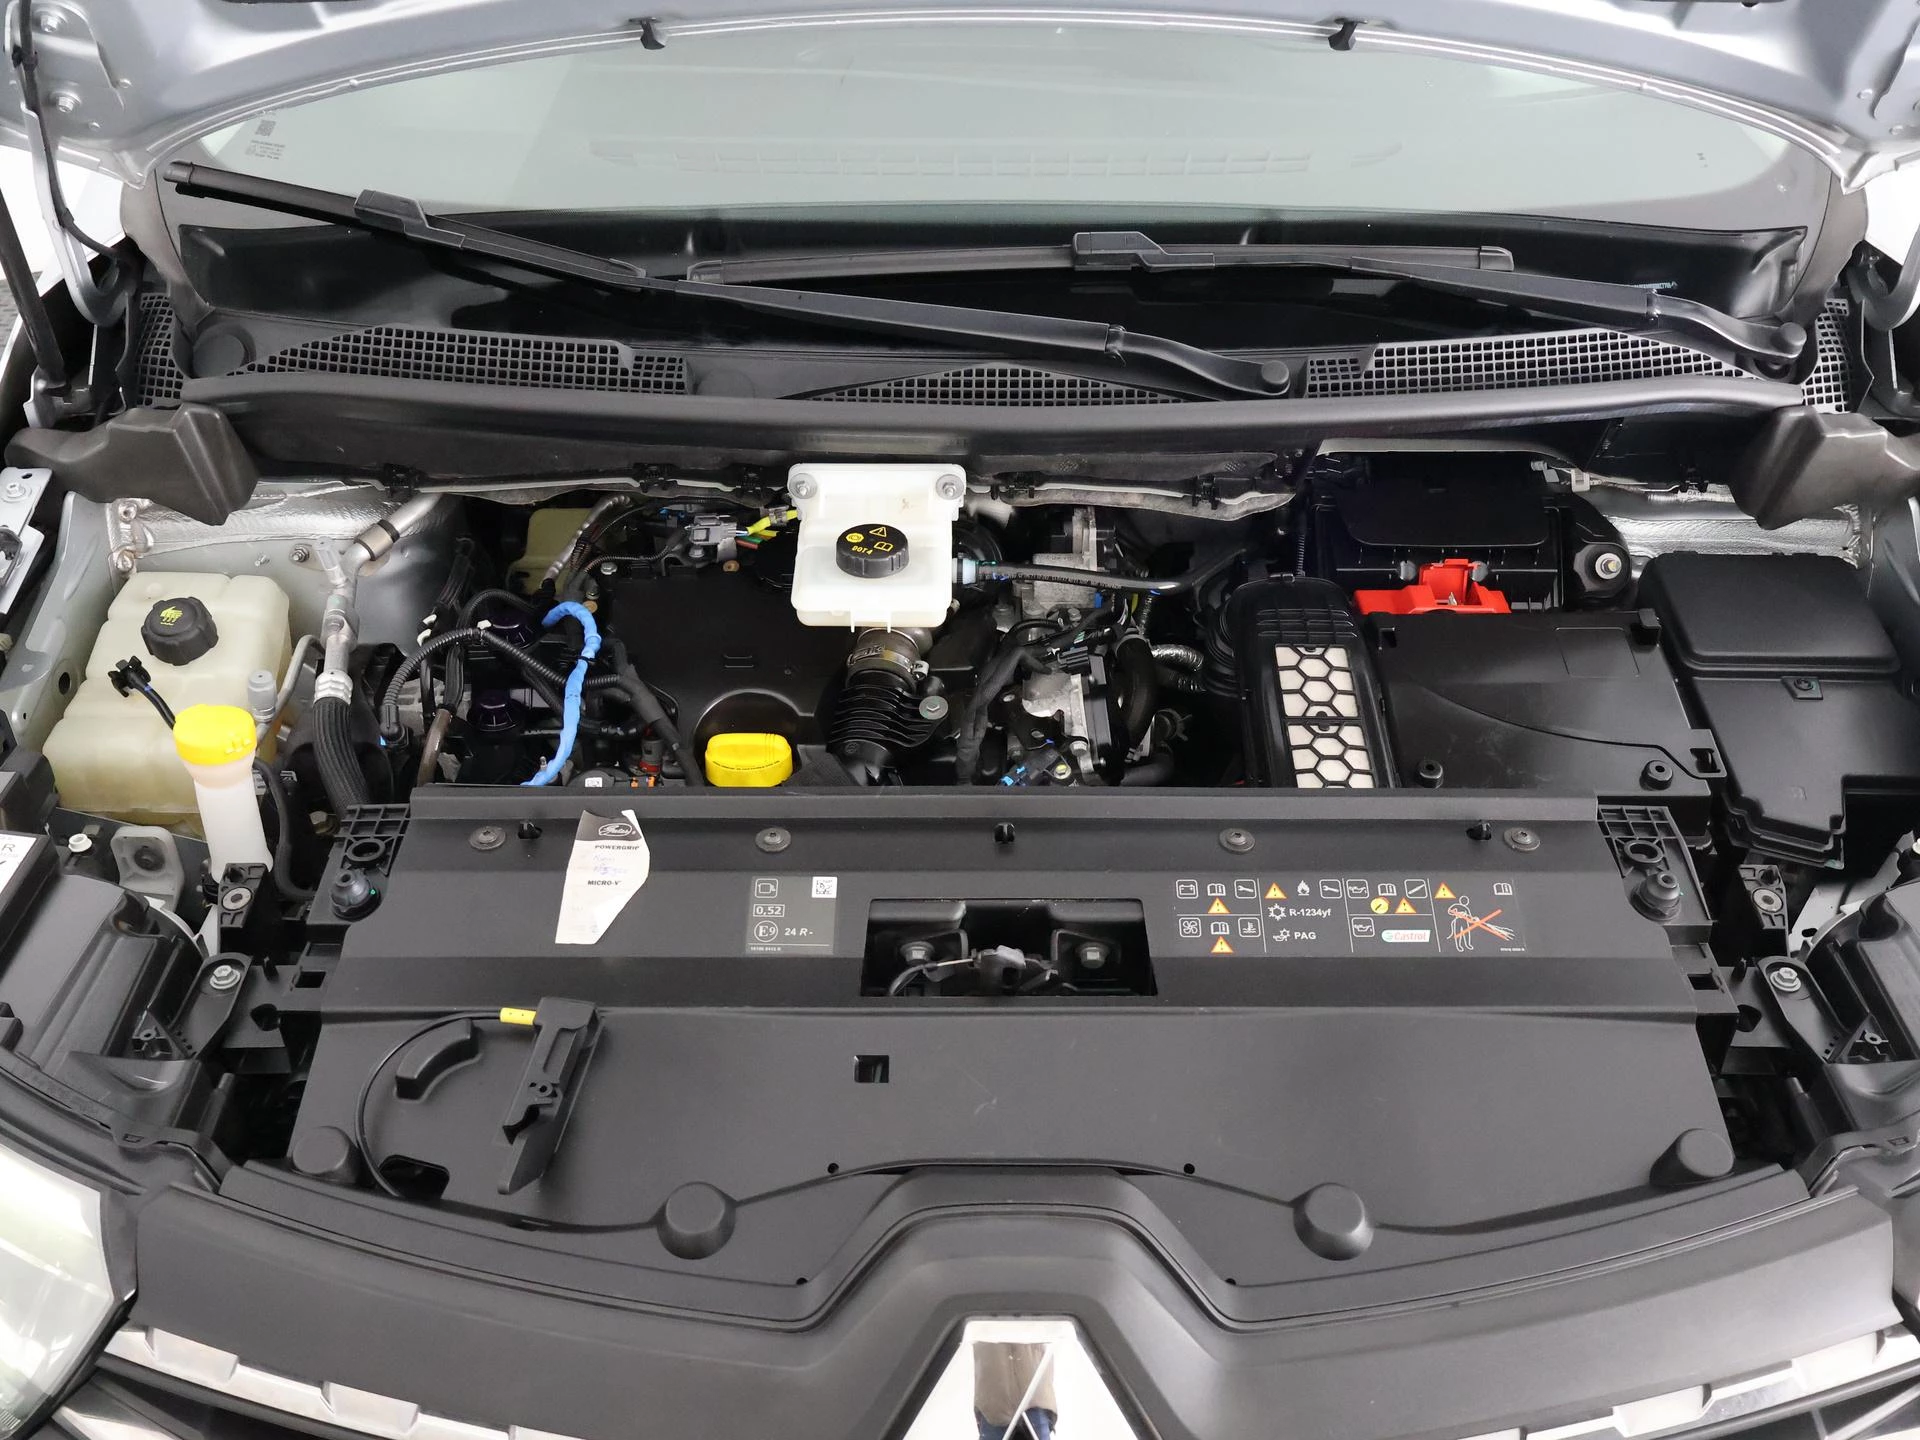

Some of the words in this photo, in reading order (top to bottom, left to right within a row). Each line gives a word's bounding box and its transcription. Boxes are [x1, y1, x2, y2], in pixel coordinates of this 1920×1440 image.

[1289, 908, 1332, 918] R-1234yf
[784, 927, 797, 936] 24
[1294, 931, 1317, 940] PAG
[1394, 932, 1427, 941] Castrol
